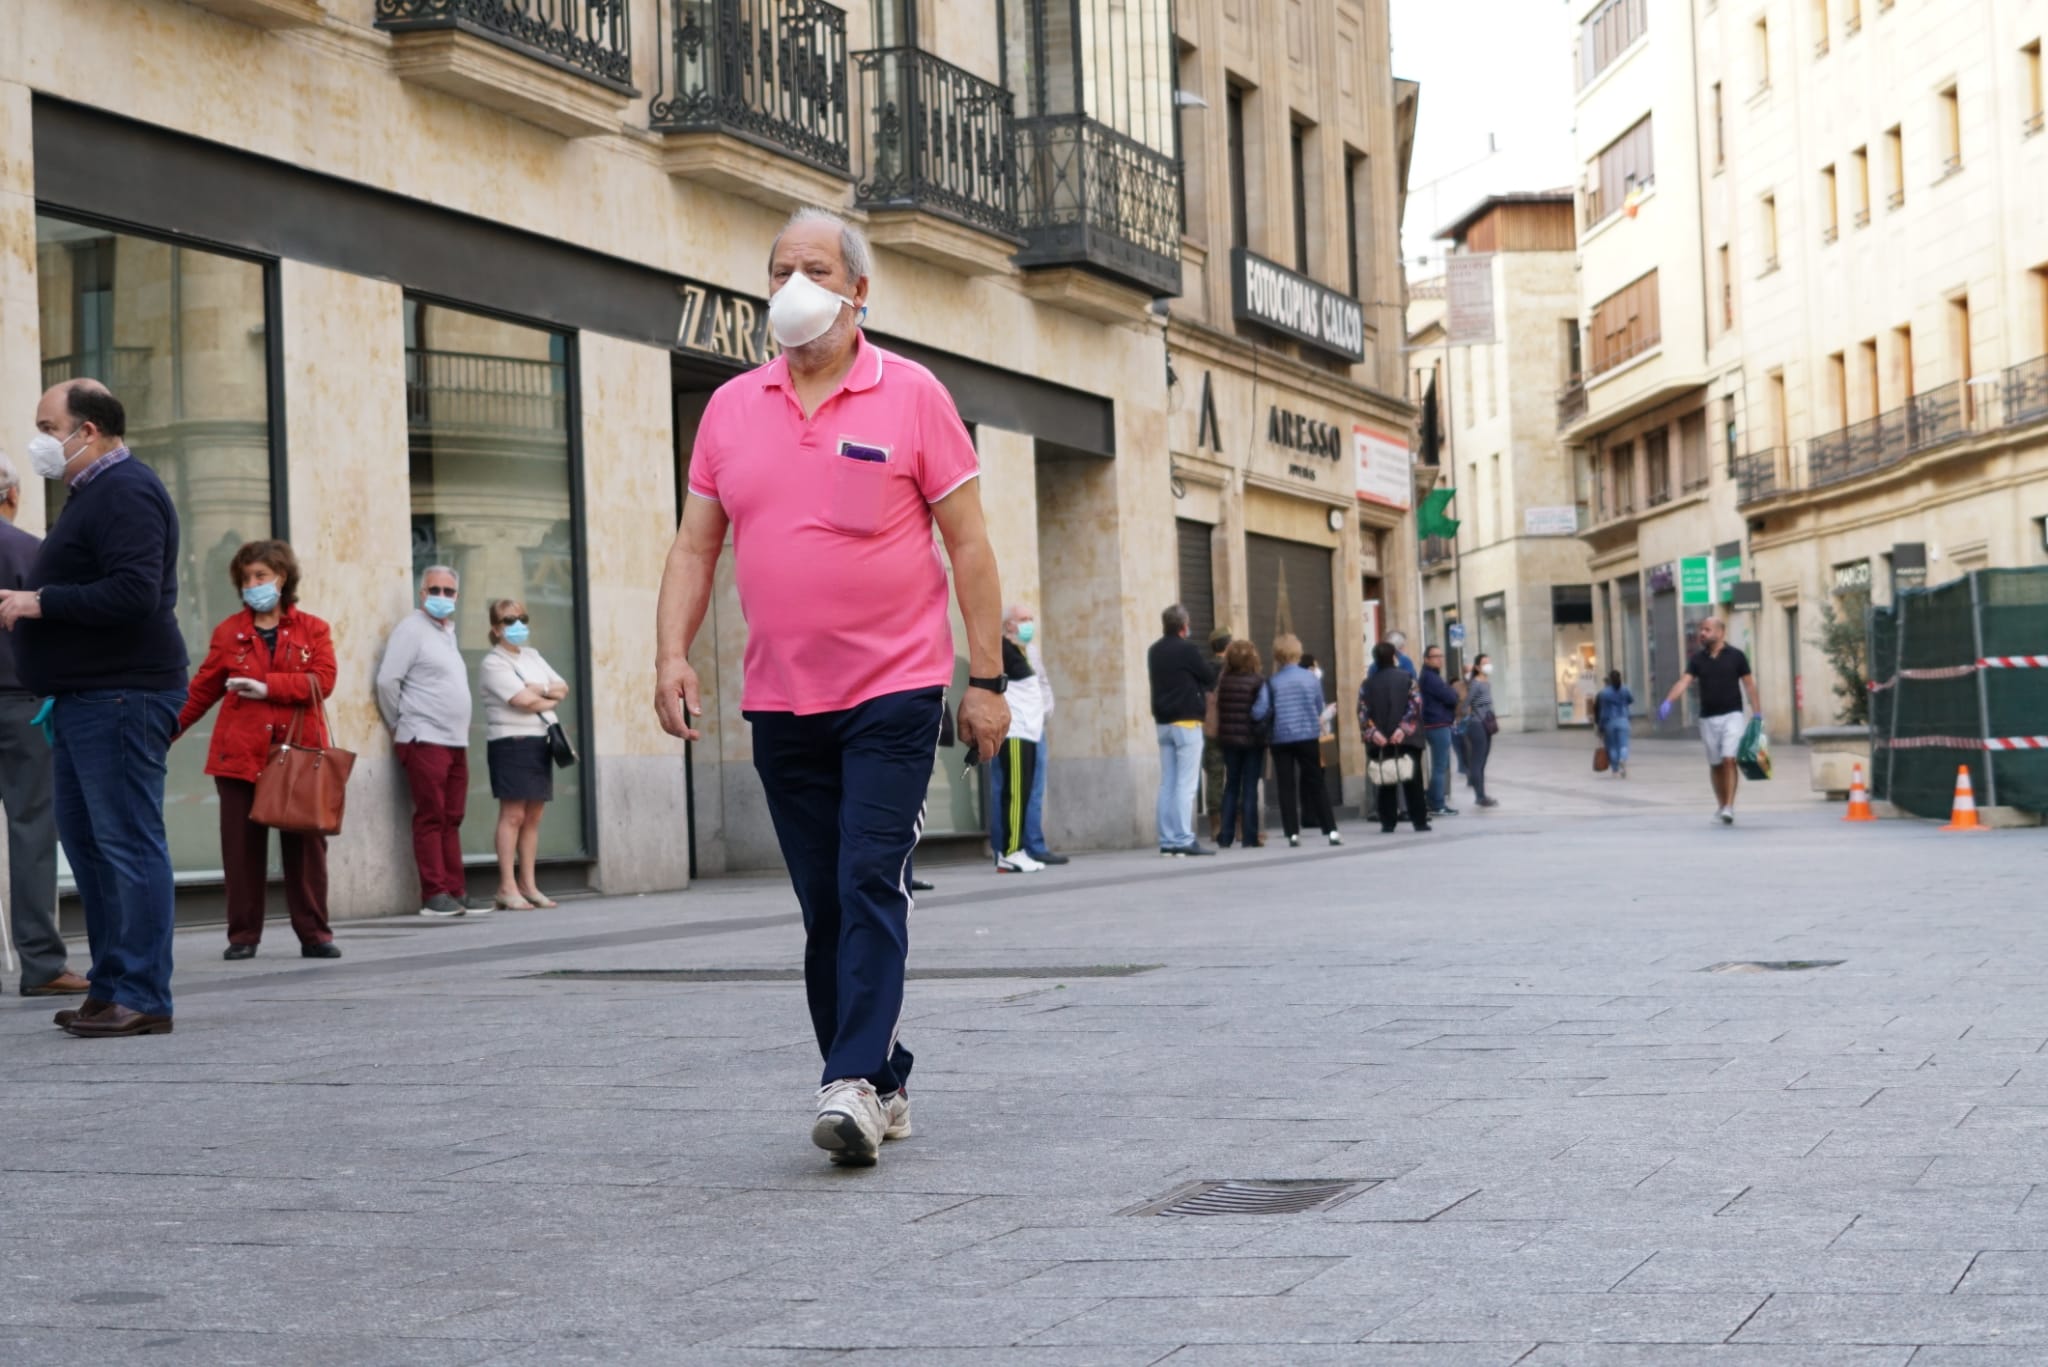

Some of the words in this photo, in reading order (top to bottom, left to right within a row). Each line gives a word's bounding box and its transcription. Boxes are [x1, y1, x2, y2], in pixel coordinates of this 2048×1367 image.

[679, 285, 779, 364] ZARA
[1246, 258, 1319, 338] FOTOCOPIAS
[1322, 293, 1362, 354] CALCO
[1268, 405, 1341, 462] ARESSO
[1836, 564, 1869, 588] MANGO
